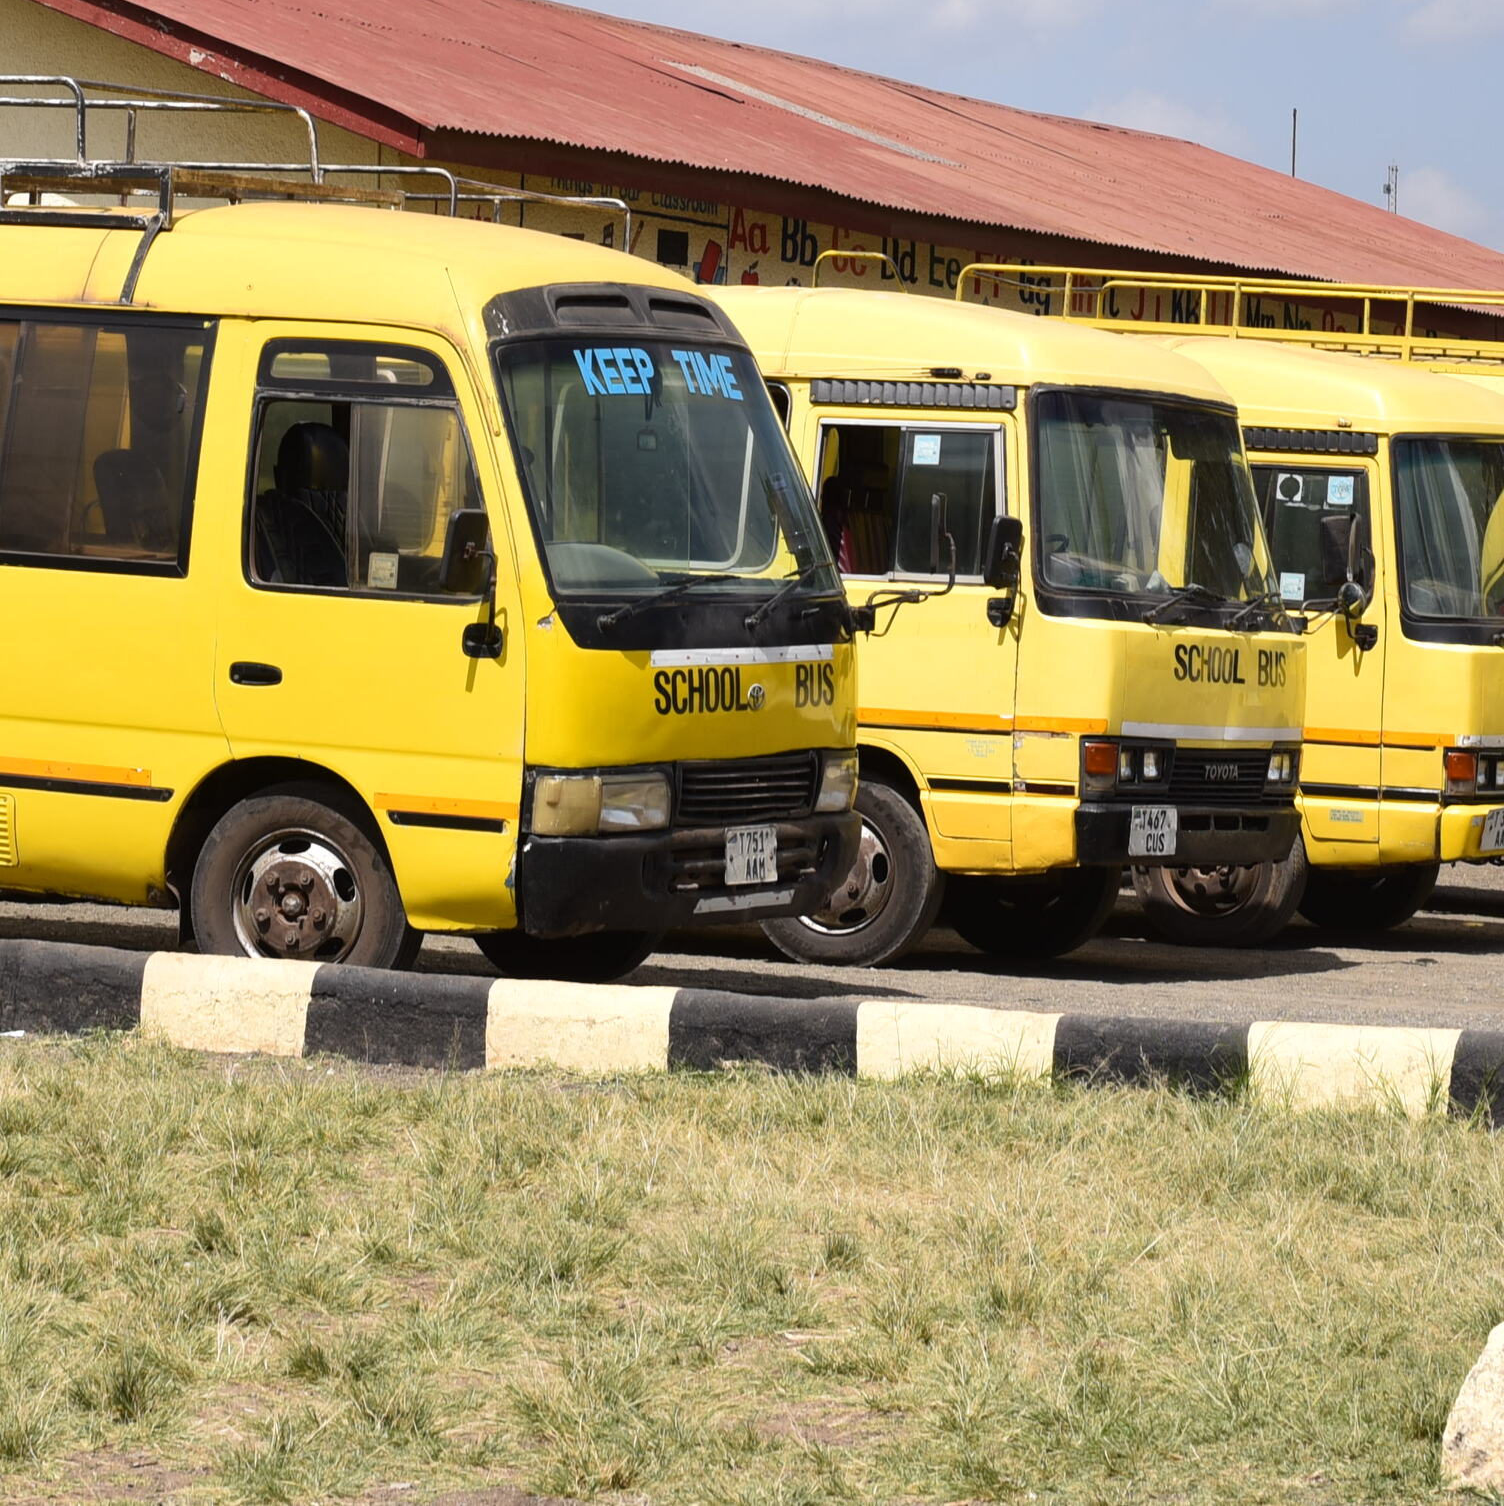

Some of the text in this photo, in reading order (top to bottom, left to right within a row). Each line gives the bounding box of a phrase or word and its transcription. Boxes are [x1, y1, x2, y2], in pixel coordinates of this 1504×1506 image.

[729, 205, 770, 255] Aa
[780, 214, 818, 267] Bb
[830, 225, 868, 277] Cc
[928, 244, 962, 290] Ee
[573, 347, 744, 401] KEEP TIME
[653, 662, 835, 716] SCHOOL BUS
[1174, 643, 1287, 688] SCHOOL BUS
[1204, 764, 1239, 781] TOYOTA
[1145, 833, 1165, 853] CUS
